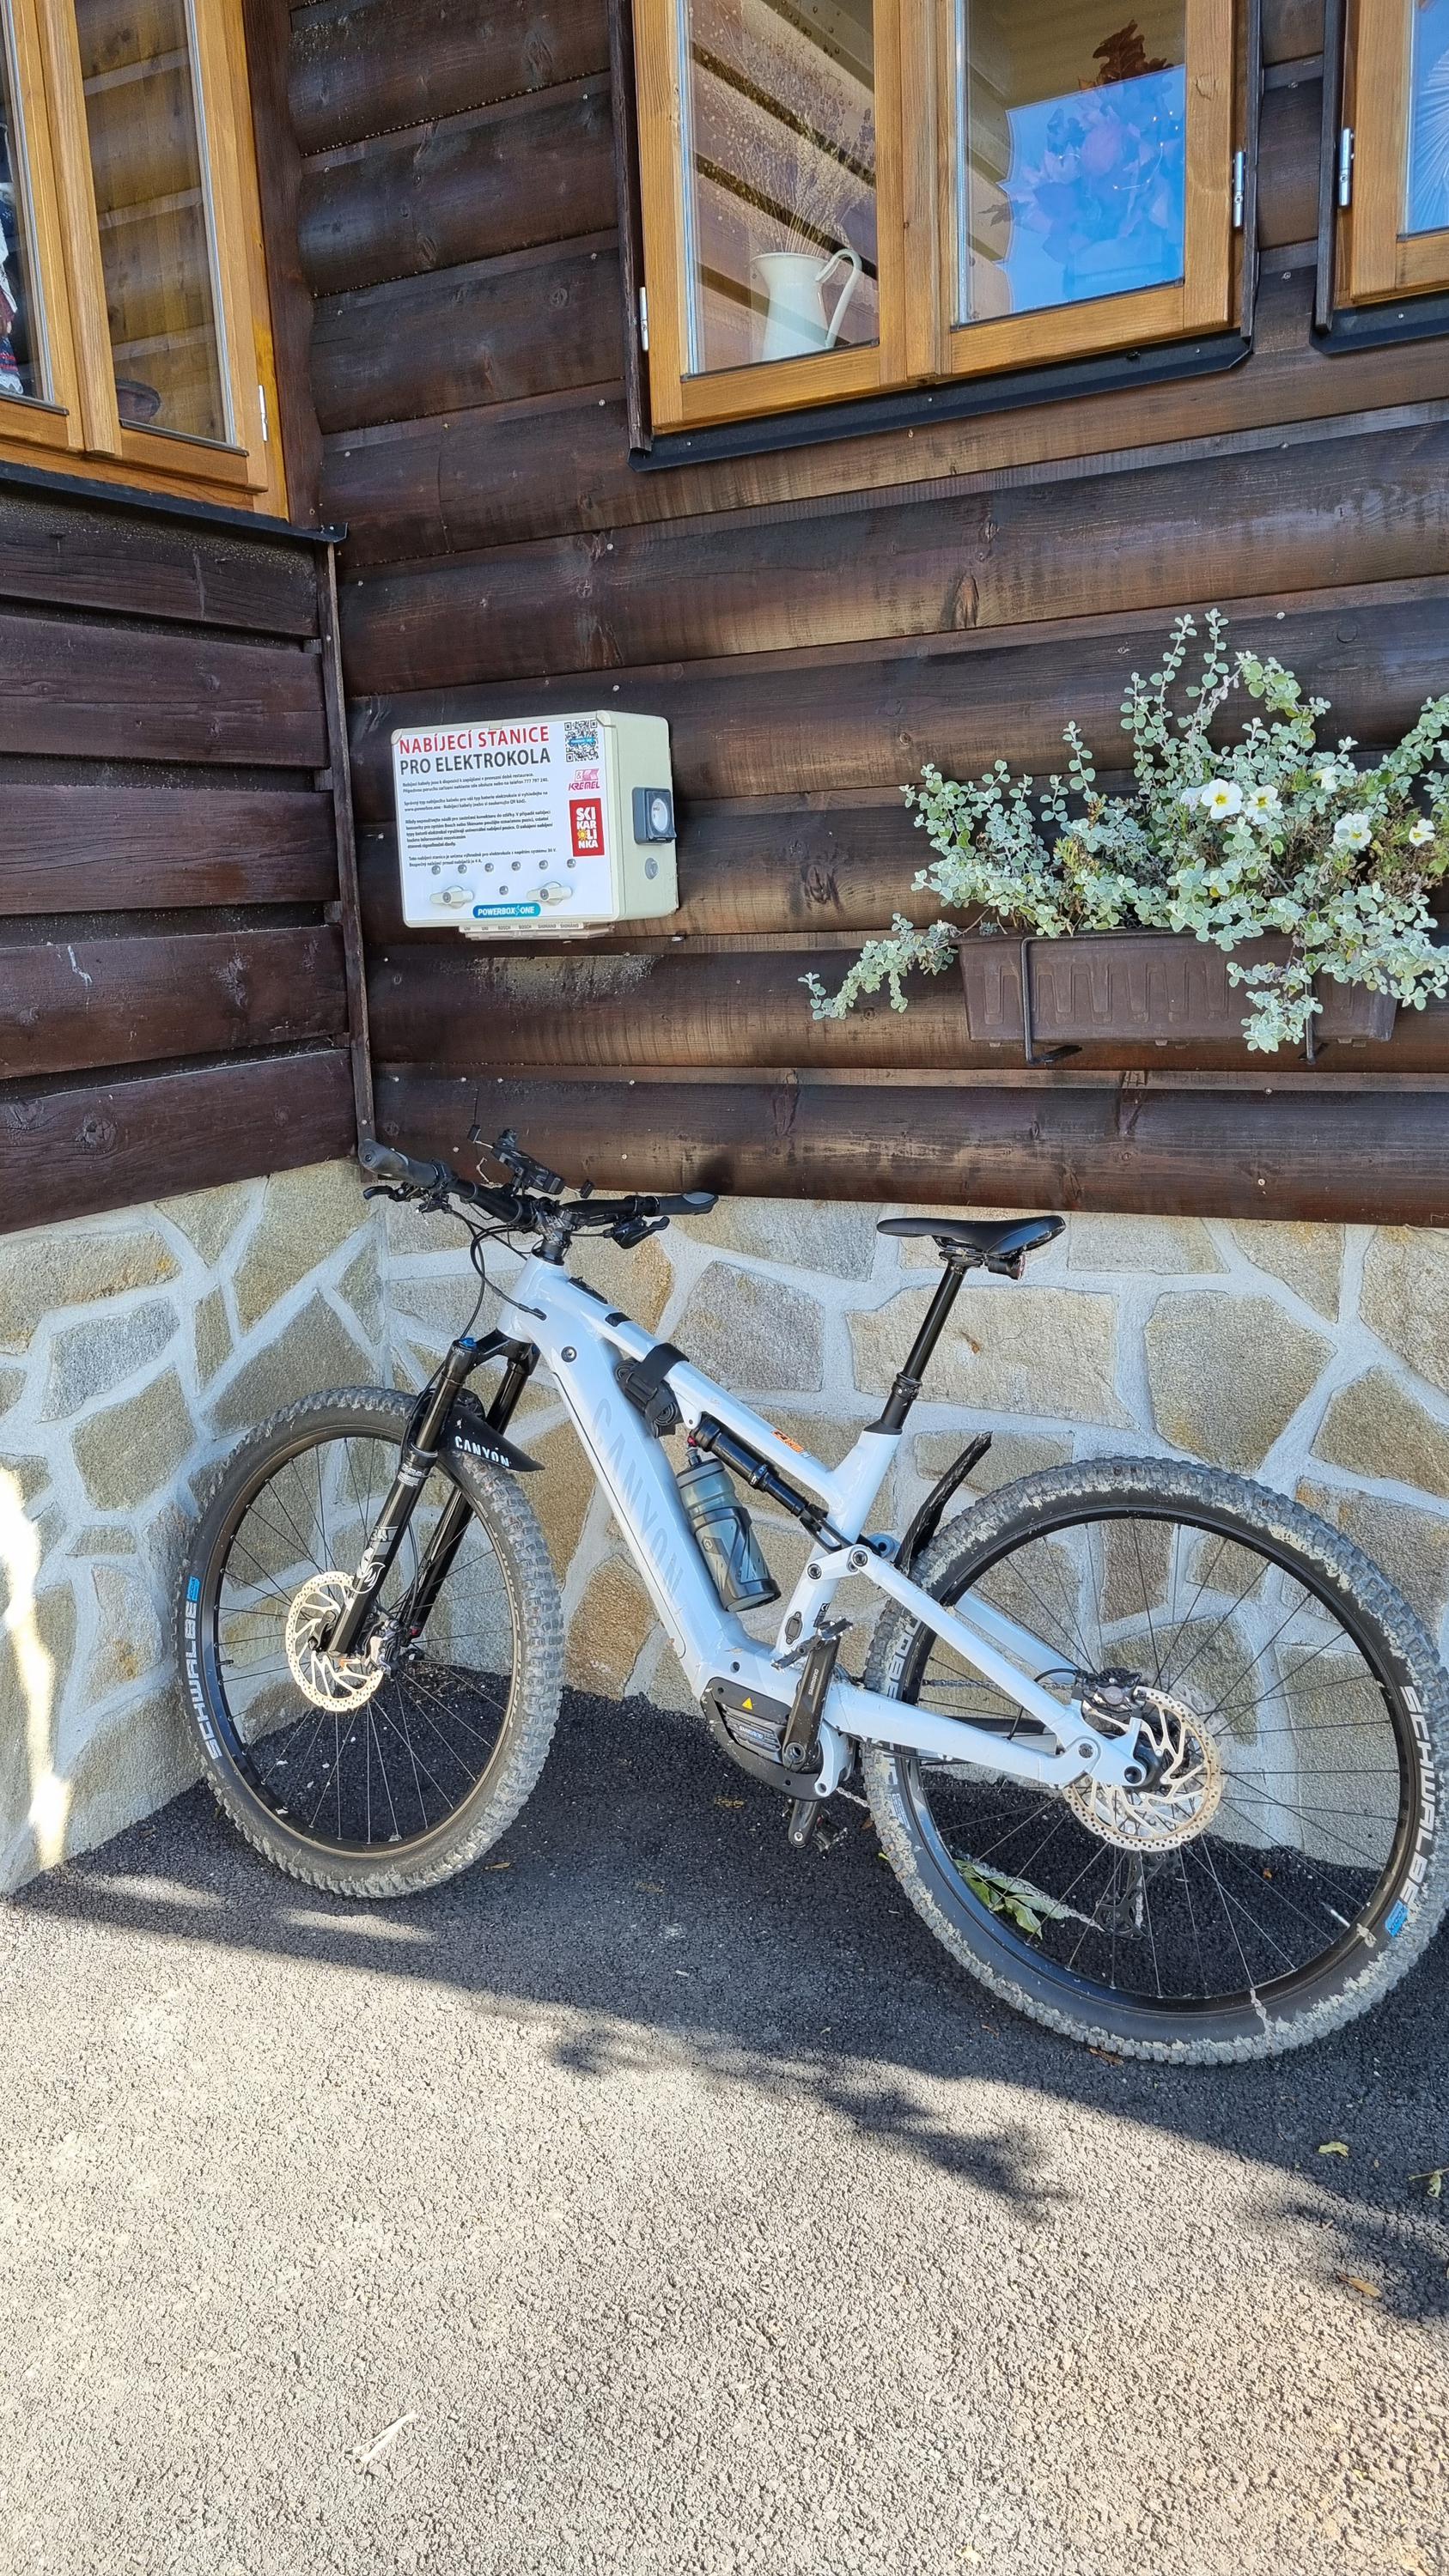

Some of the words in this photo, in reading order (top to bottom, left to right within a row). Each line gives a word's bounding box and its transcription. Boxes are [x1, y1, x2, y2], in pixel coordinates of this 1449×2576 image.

[399, 730, 472, 755] NABÍJECÍ
[478, 726, 550, 749] STANICE
[400, 757, 431, 775] PRO
[435, 747, 551, 772] ELEKTROKOLA
[568, 781, 600, 791] KREMEL
[576, 806, 596, 821] SKI
[576, 820, 596, 829] KAR
[578, 839, 599, 849] NKA
[478, 905, 515, 916] POWERBOX
[520, 905, 535, 914] ONE
[454, 1436, 510, 1467] CANYON
[593, 1398, 684, 1601] CANYON
[185, 1601, 222, 1760] SCHWALBE
[808, 1668, 819, 1696] SHIMANO
[1399, 1686, 1436, 1905] SCHWALBE
